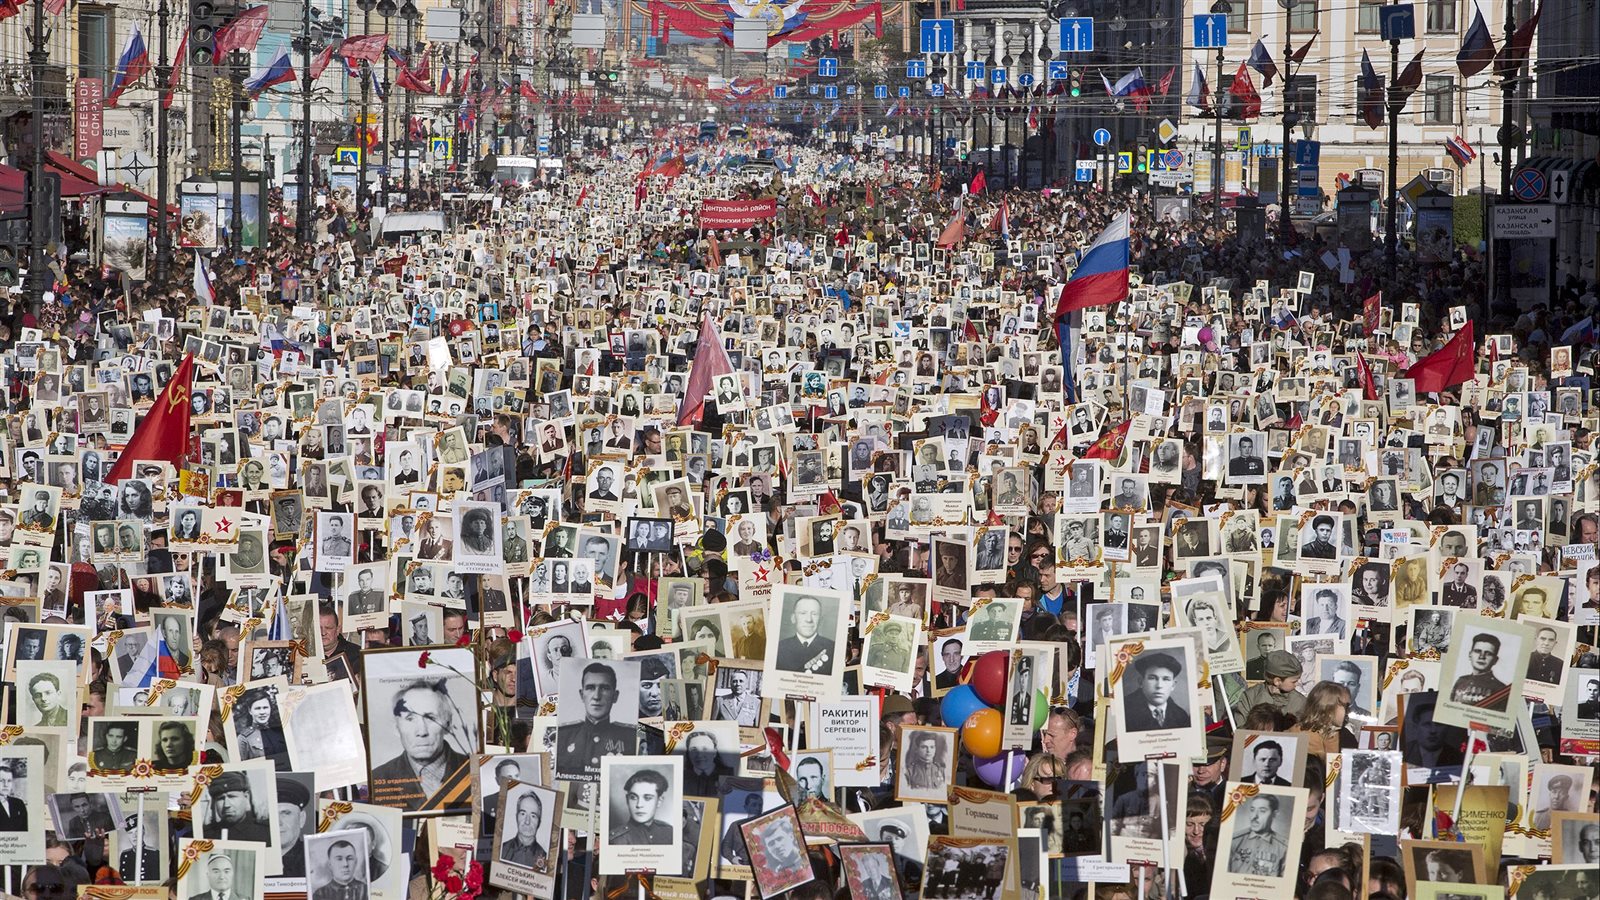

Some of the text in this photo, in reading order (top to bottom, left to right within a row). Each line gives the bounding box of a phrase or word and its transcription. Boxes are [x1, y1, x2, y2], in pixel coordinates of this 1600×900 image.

[91, 82, 100, 137] COMPANY
[80, 81, 89, 157] COFFEESHOP
[702, 204, 771, 213] Центральный район
[1563, 544, 1595, 555] НЕВСКИЙ
[822, 709, 869, 718] РАКИТИН
[824, 726, 867, 734] СЕРГЕЕВИЧ
[556, 772, 593, 783] Александр
[965, 807, 999, 821] Гордеевы
[506, 867, 535, 881] СЕНЬКИН
[495, 872, 548, 891] АЛЕКСЕЙ ИВАНОВИЧ
[140, 888, 158, 896] ПОЛК
[679, 891, 698, 899] ПОЛК
